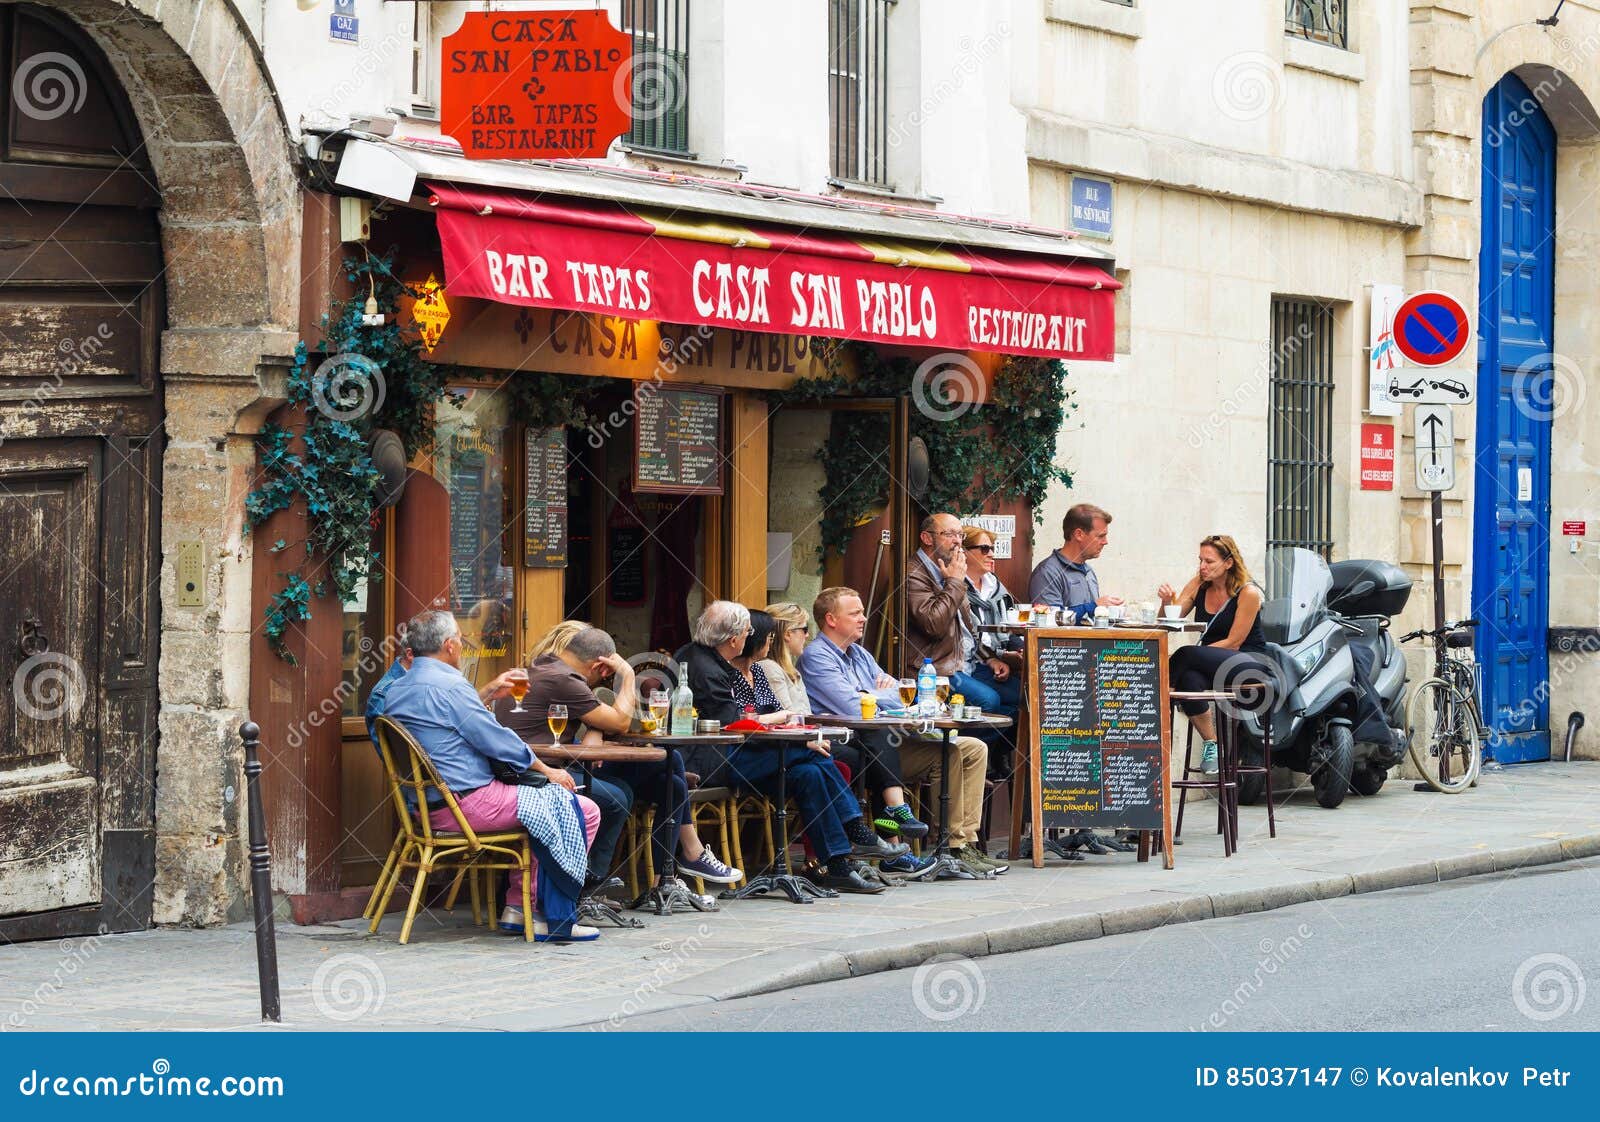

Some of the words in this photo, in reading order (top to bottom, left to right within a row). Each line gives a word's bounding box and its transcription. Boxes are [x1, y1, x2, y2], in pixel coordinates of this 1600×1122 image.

[337, 16, 353, 31] GAZ
[491, 19, 577, 42] CASA
[451, 50, 510, 73] SAN
[531, 48, 621, 73] PABLO
[471, 105, 515, 125] BAR
[533, 104, 598, 124] TAPAS
[471, 129, 597, 149] RESTAURANT
[1086, 187, 1099, 201] RUE
[1073, 205, 1083, 219] DE
[486, 250, 554, 300] BAR
[566, 260, 651, 312] TAPAS
[692, 259, 771, 325] CASA
[790, 271, 845, 331] SAN
[855, 278, 937, 339] PABLO
[968, 305, 1088, 353] RESTAURANT
[550, 310, 640, 361] CASA
[659, 321, 713, 367] SAN
[732, 328, 809, 374] PABLO
